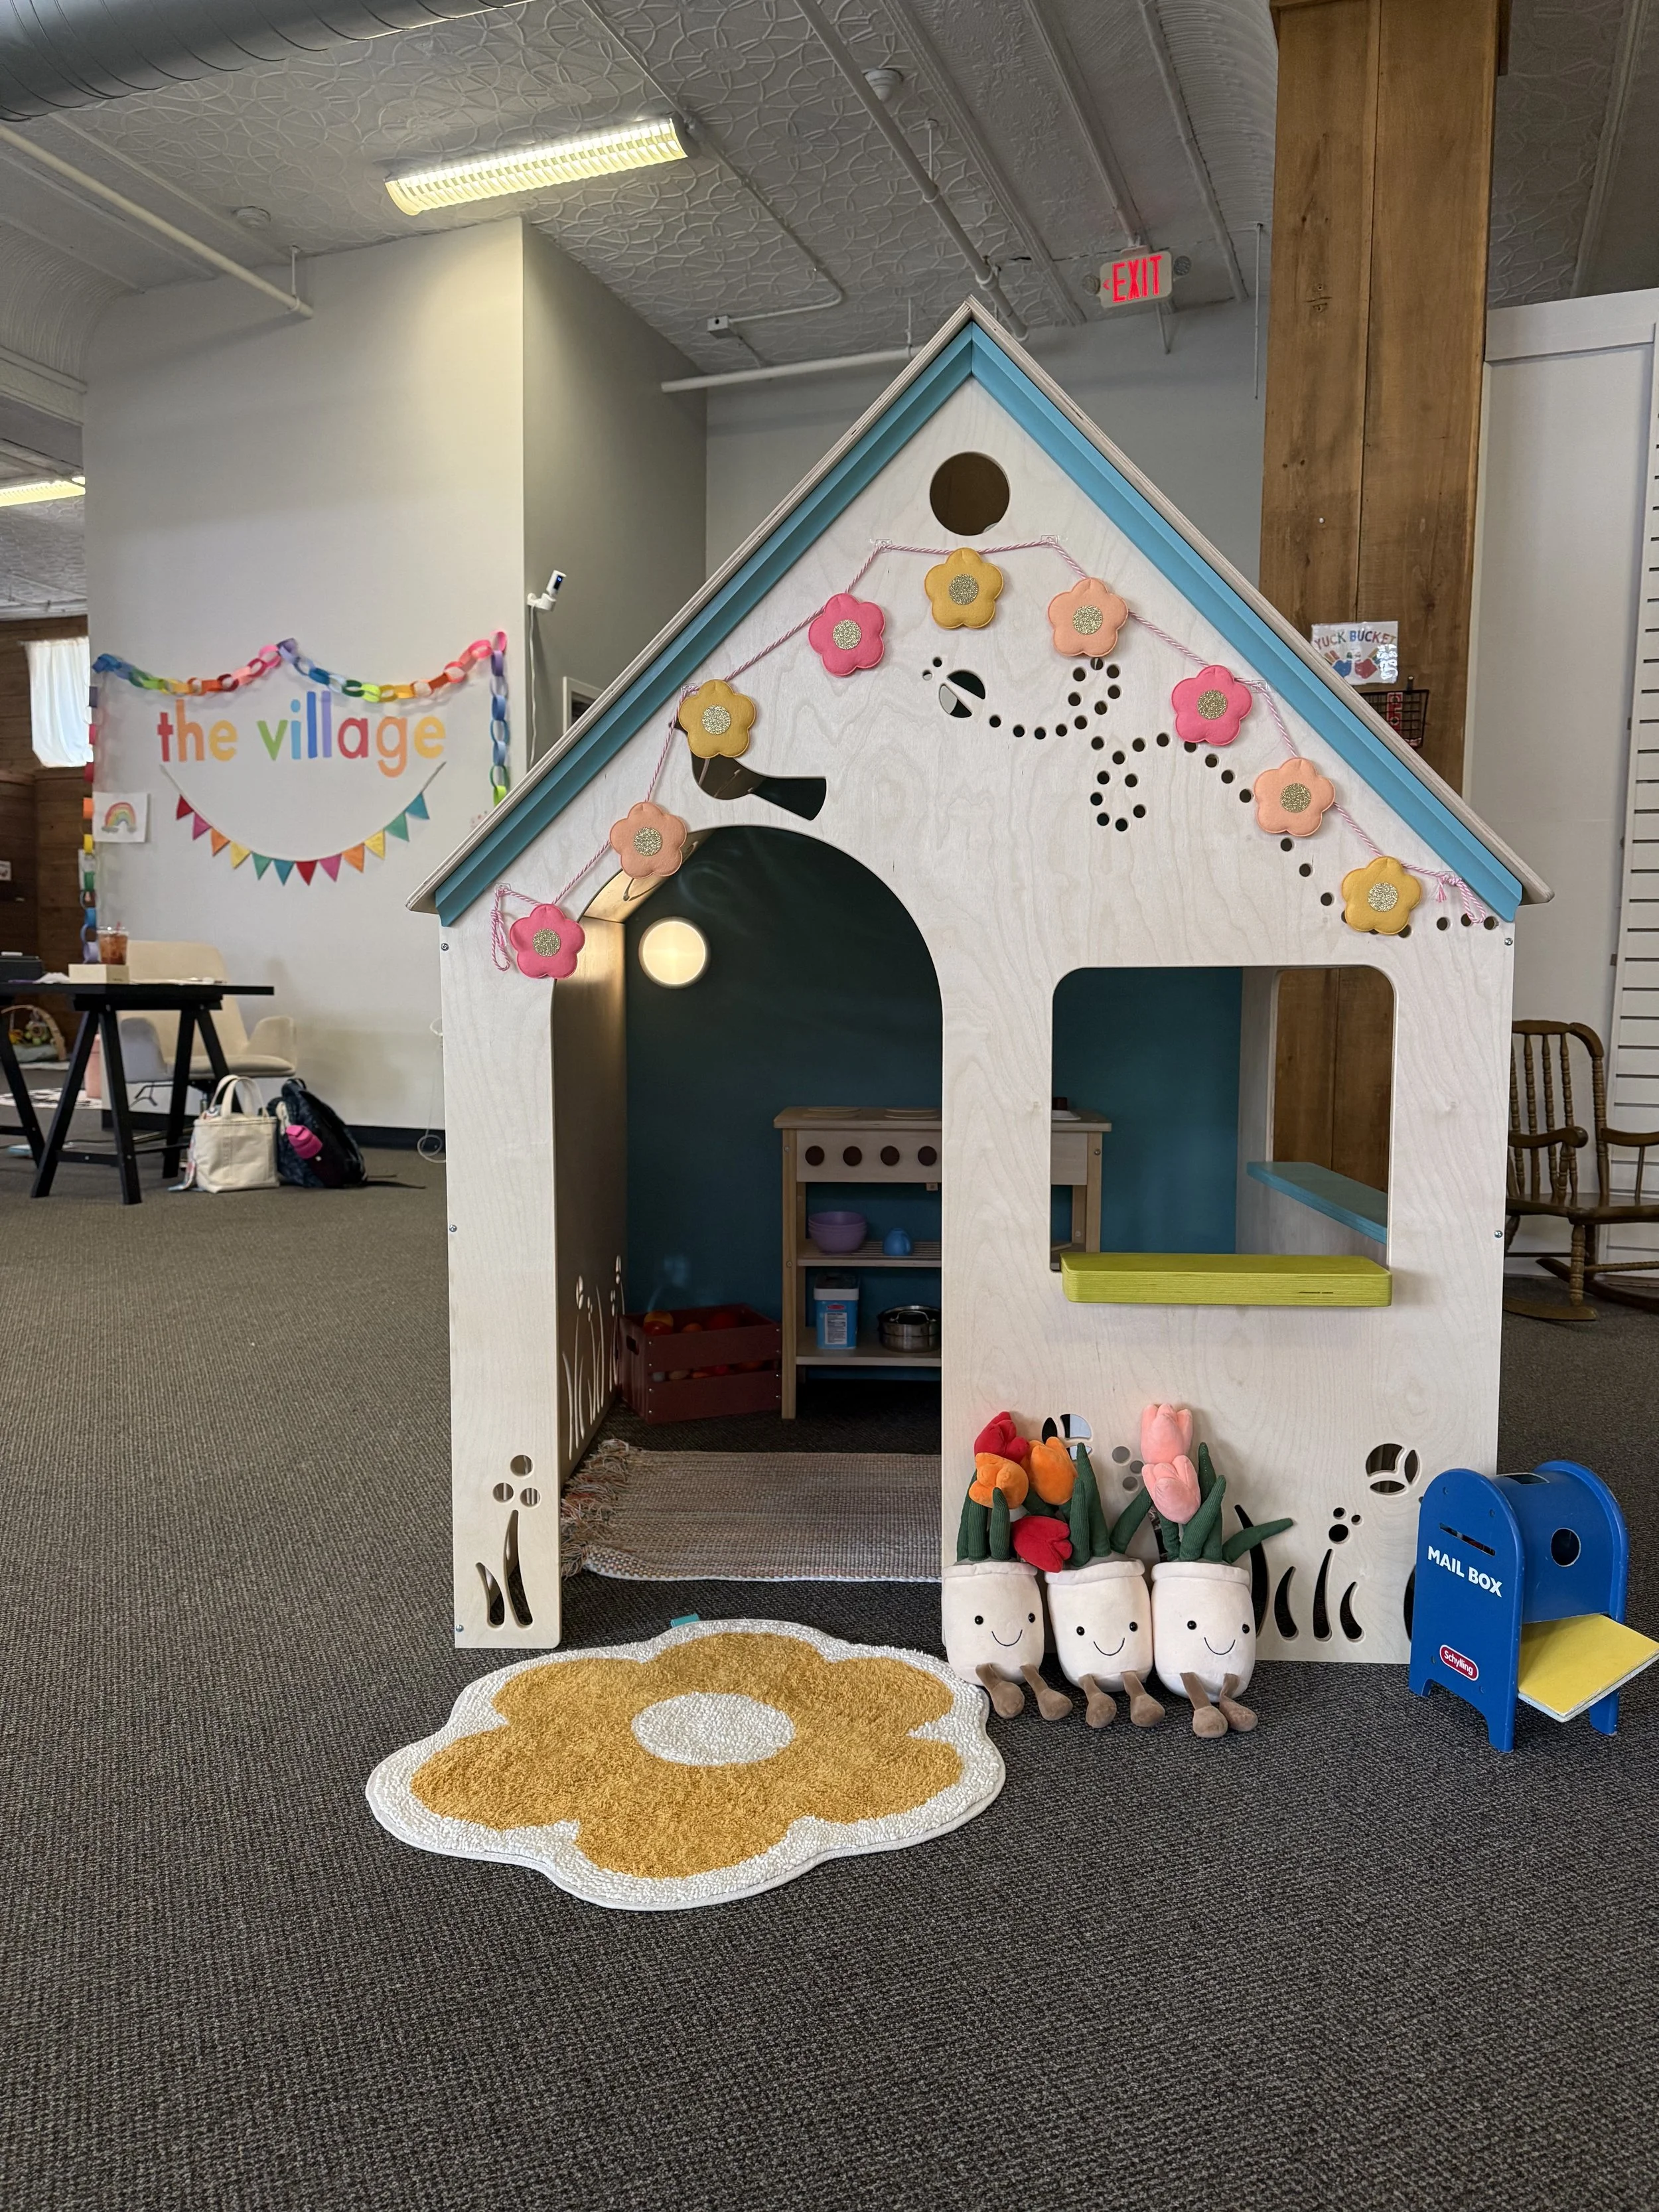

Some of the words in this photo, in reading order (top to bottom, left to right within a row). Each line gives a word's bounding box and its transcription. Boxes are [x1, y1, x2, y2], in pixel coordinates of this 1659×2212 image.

[1112, 255, 1163, 303] EXIT
[1314, 630, 1346, 650] YUCK
[1349, 630, 1397, 645] BUCKET
[157, 699, 238, 762] the
[257, 691, 446, 778] village
[1427, 1545, 1465, 1578] MAIL
[1468, 1566, 1502, 1597] BOX
[1443, 1650, 1473, 1676] Schylling
